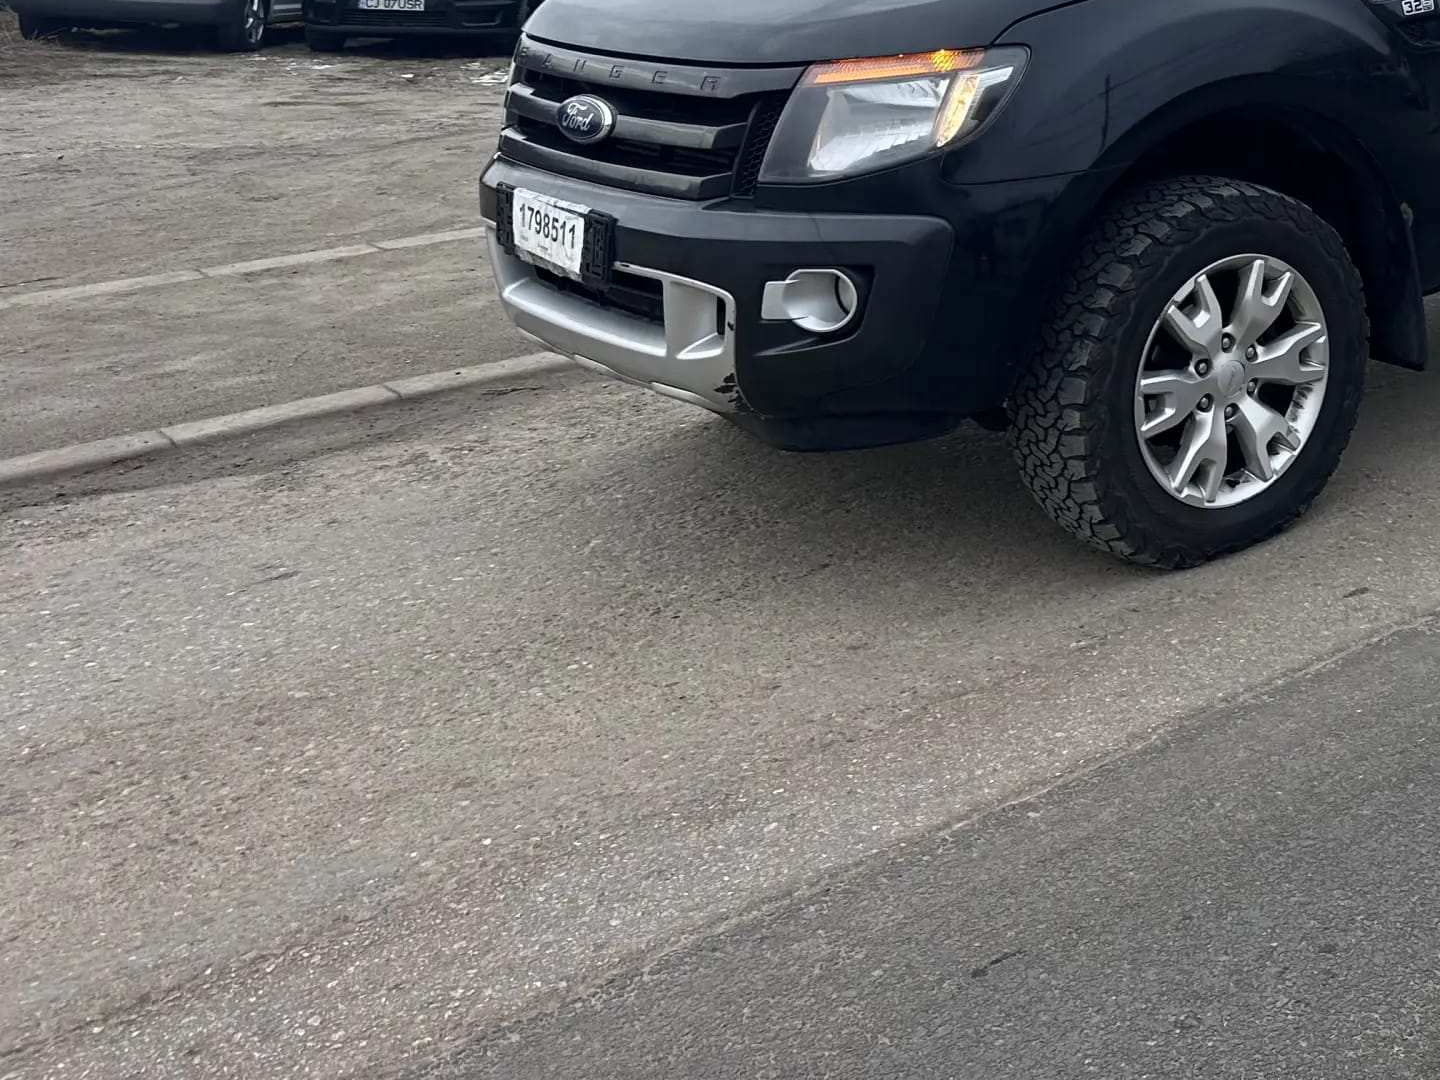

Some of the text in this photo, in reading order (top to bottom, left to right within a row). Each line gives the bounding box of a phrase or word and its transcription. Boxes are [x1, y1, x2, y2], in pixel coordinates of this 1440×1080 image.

[519, 46, 721, 92] RANGER
[562, 102, 594, 132] Ford
[519, 202, 577, 249] 1798511
